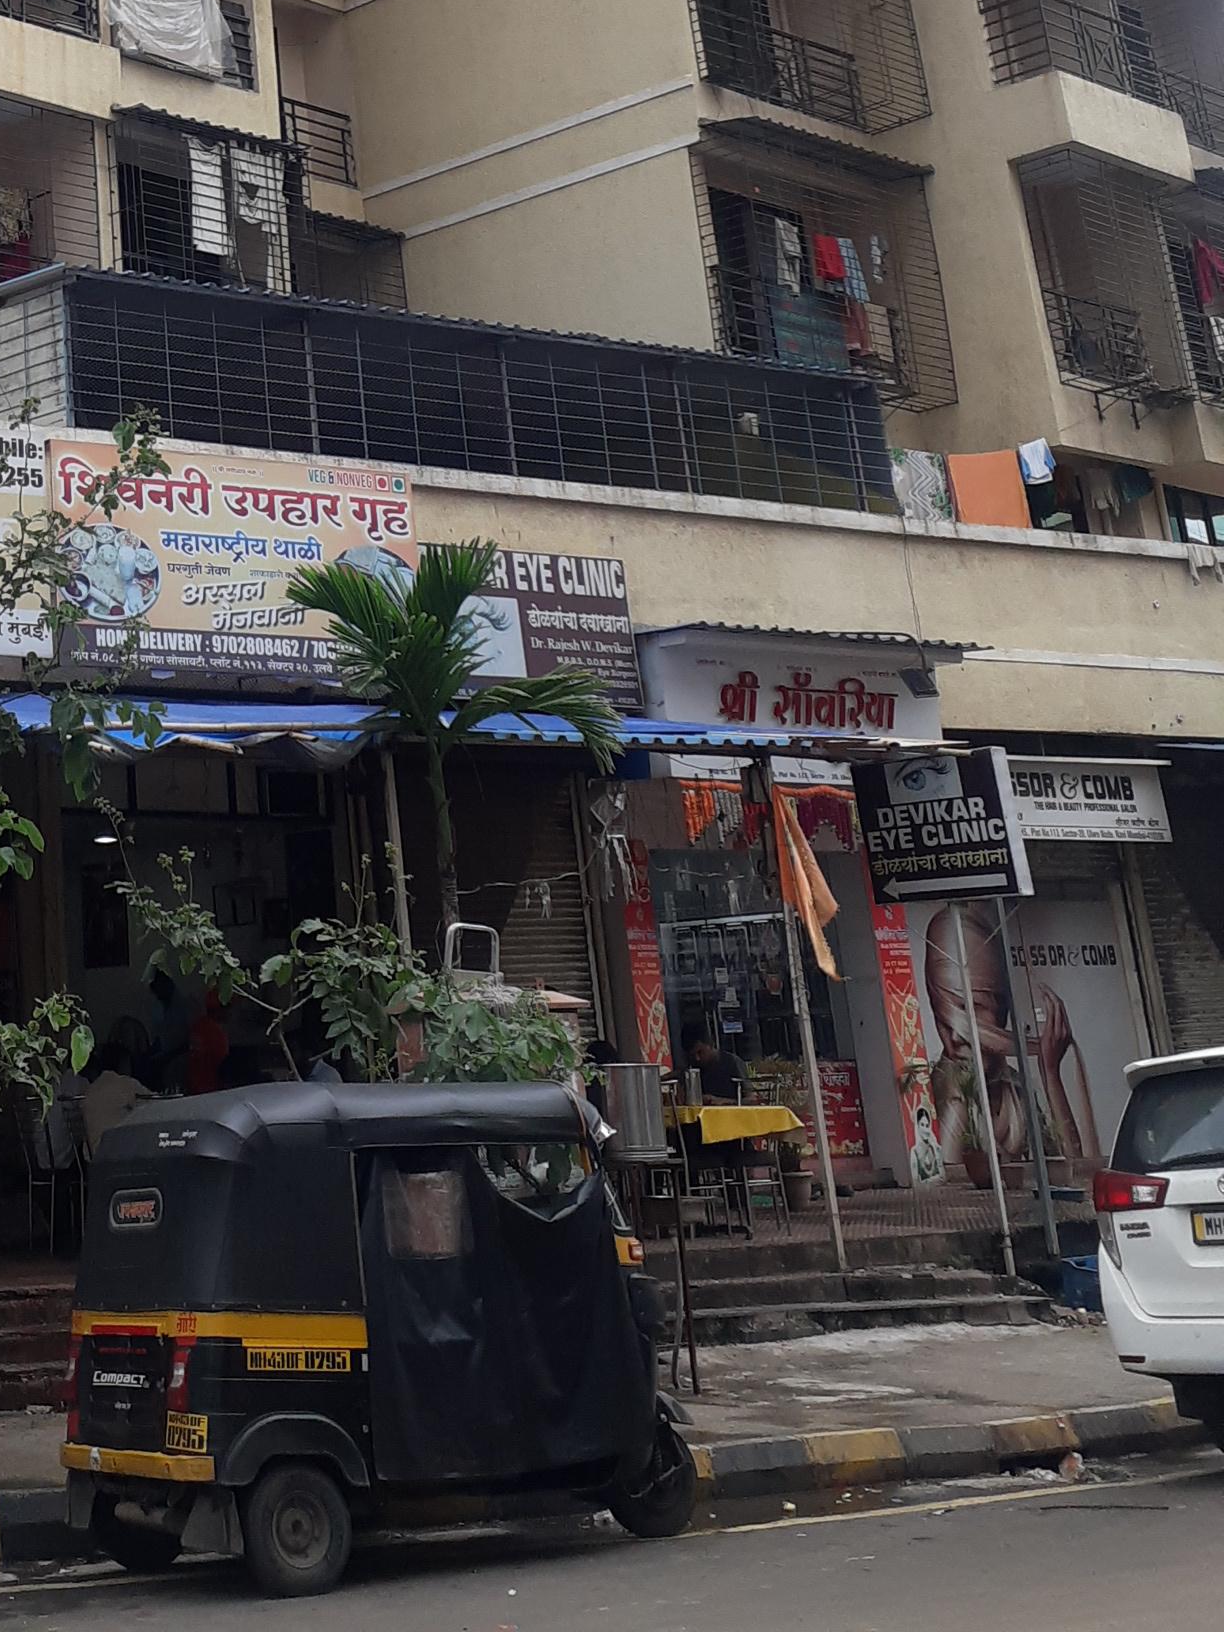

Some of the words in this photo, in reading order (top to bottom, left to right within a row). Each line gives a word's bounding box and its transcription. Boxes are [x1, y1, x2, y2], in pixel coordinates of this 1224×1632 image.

[308, 469, 326, 484] VEG
[327, 471, 335, 485] &
[336, 472, 373, 488] NONVEG
[222, 484, 343, 528] उपहार
[349, 496, 410, 541] गृह
[160, 529, 268, 563] महाराष्ट्रीय
[273, 536, 323, 561] थाळी
[167, 562, 202, 579] घरगुती
[205, 562, 231, 577] जेवण
[512, 552, 556, 595] EYE
[558, 556, 626, 600] CLINIC
[181, 580, 266, 606] अस्सल
[578, 613, 630, 635] दवाखाना
[139, 634, 203, 653] DELIVERY
[212, 634, 300, 658] 9702808462
[530, 636, 546, 649] Dr.
[547, 637, 580, 653] Rajesh
[596, 641, 633, 655] Devikar
[719, 670, 761, 723] श्री
[1060, 772, 1079, 799] &
[1081, 774, 1135, 801] COMB
[877, 796, 987, 829] DEVIKAR
[867, 828, 915, 852] EYE
[921, 818, 1006, 847] CLINIC
[939, 848, 1009, 870] दवाखाना
[1081, 944, 1117, 966] COMB
[93, 1370, 146, 1386] Compact
